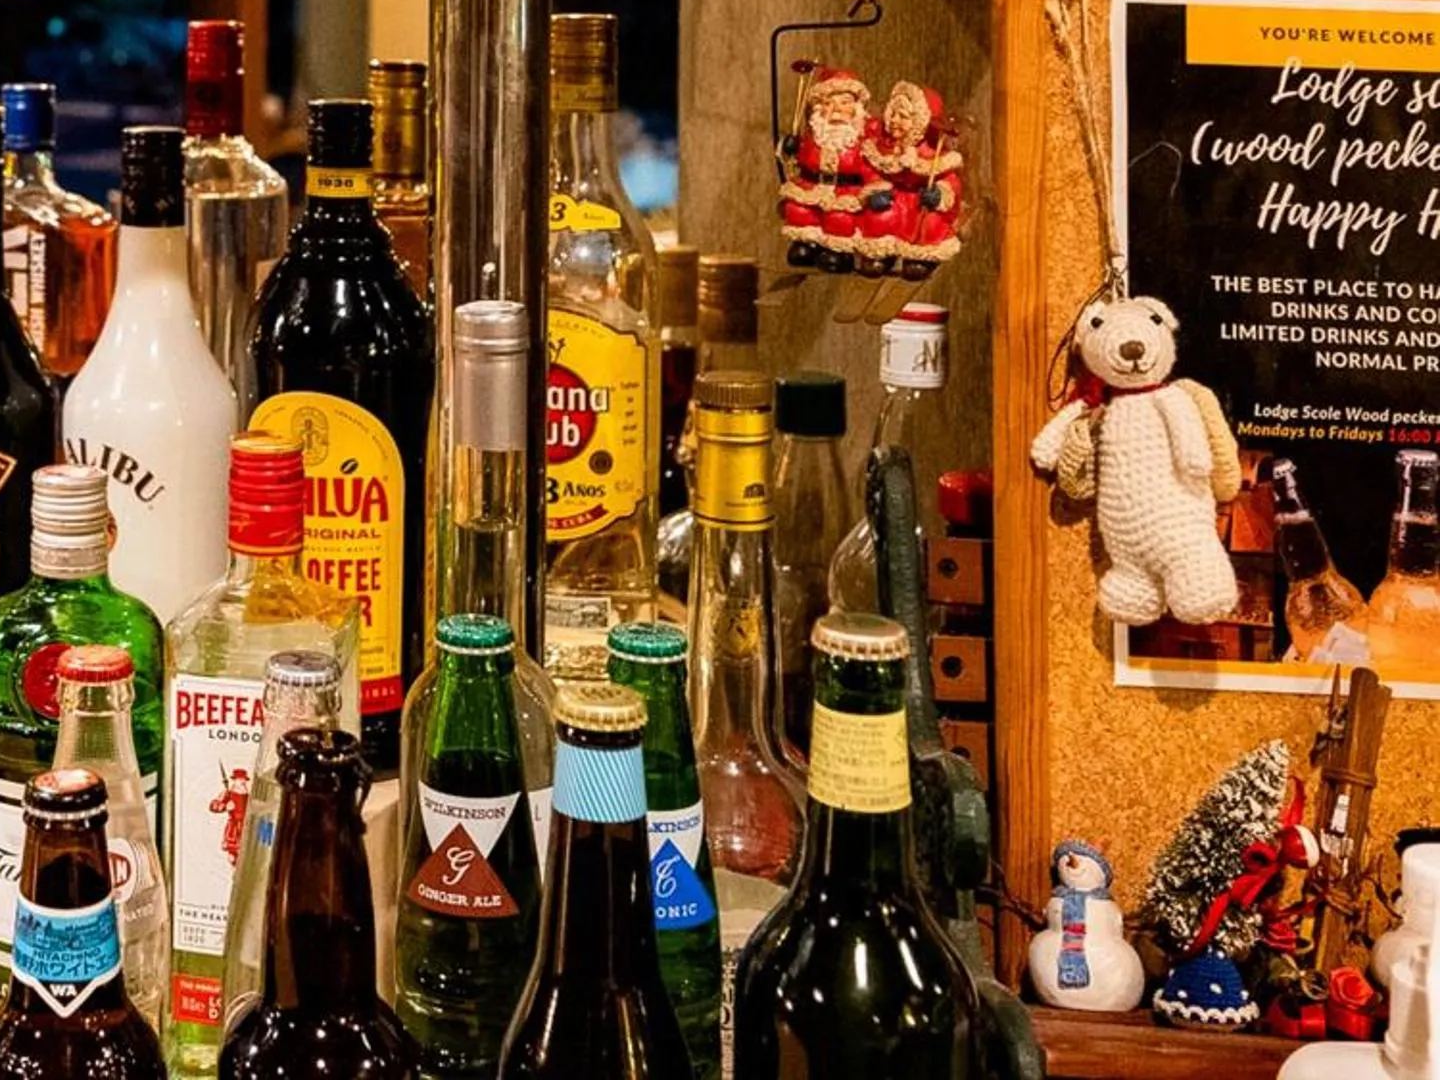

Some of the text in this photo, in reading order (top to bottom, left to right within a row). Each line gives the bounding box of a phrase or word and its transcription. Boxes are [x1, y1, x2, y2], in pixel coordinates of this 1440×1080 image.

[1260, 26, 1436, 46] YOU'RE WELCOME
[1271, 56, 1399, 126] Lodge
[551, 202, 567, 222] 3
[1256, 181, 1408, 256] Happy
[1211, 275, 1253, 293] THE
[1258, 277, 1308, 296] BEST
[1313, 279, 1378, 299] PLACE
[1383, 282, 1413, 299] TO
[1271, 301, 1349, 321] DRINKS
[1355, 305, 1401, 323] AND
[1220, 323, 1440, 348] LIMITED DRINKS AND
[1315, 351, 1408, 371] NORMAL
[547, 385, 610, 413] ana
[1254, 403, 1299, 421] Lodge
[1345, 407, 1390, 423] Wood
[1237, 421, 1306, 439] Mondays
[1309, 425, 1325, 439] to
[1328, 426, 1384, 443] Fridays
[307, 558, 382, 592] OFFEE
[176, 689, 265, 730] BEEFEA
[208, 729, 262, 743] LONDO
[424, 796, 507, 820] WILKINSON
[418, 883, 503, 907] GINGER ALE
[655, 902, 698, 918] ONIC
[32, 945, 102, 963] HITACHINO
[49, 983, 77, 997] WA
